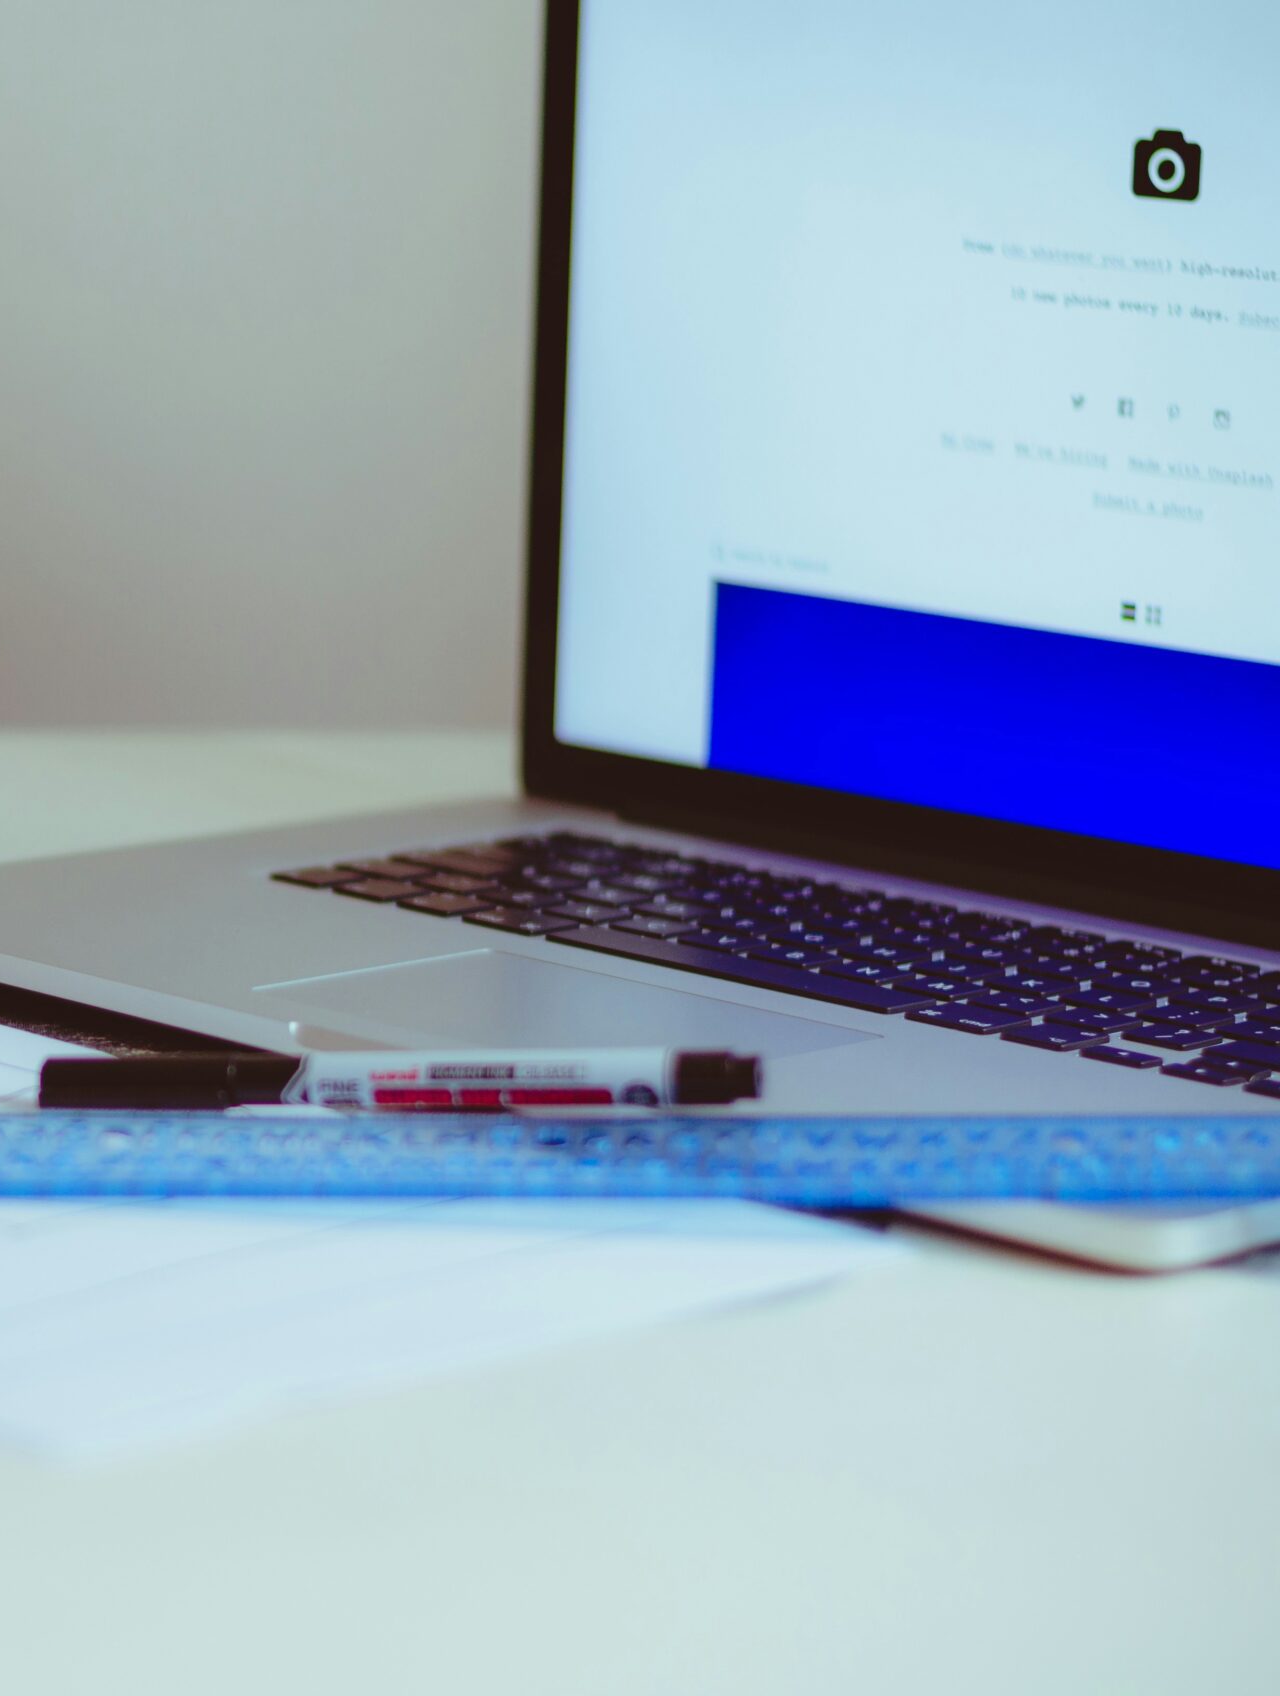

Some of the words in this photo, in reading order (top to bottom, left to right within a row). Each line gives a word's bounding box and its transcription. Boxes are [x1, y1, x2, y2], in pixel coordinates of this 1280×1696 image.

[1063, 293, 1111, 311] photos
[1119, 301, 1158, 318] every
[1190, 304, 1230, 323] days.
[319, 1078, 360, 1093] FINE
